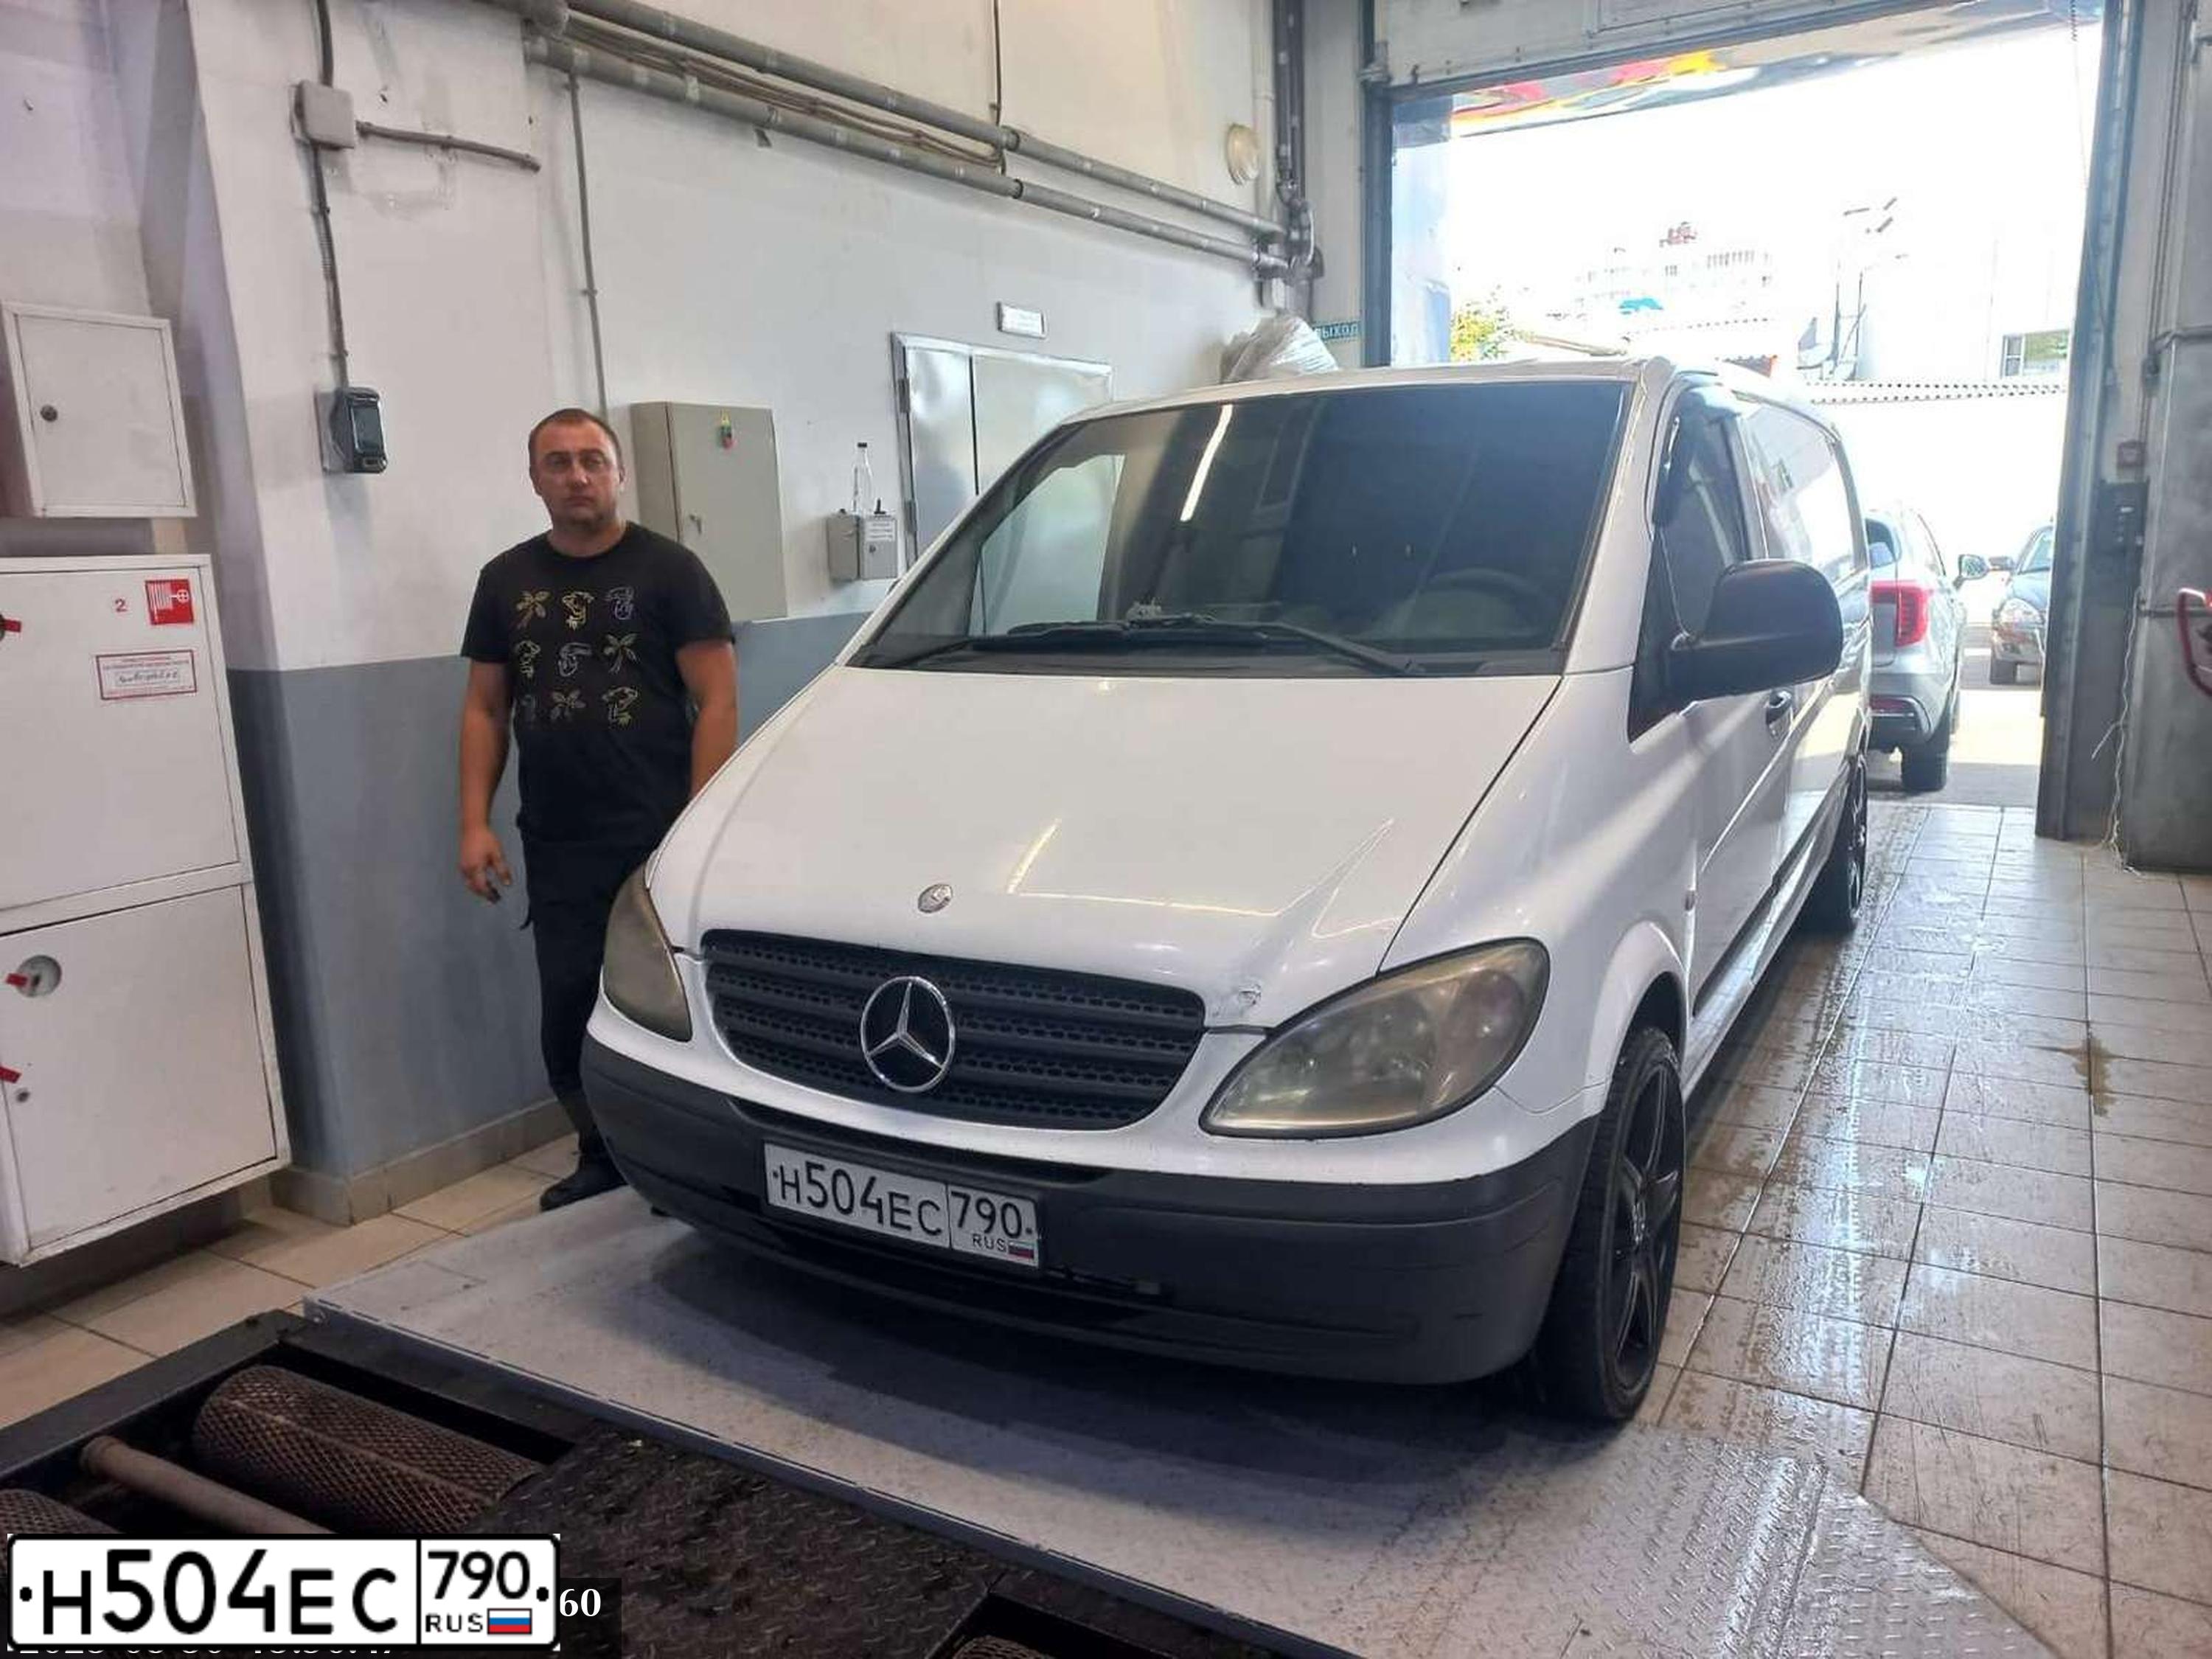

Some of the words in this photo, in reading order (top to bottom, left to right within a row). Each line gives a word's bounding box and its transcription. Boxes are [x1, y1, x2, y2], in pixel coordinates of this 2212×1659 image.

[1315, 323, 1359, 338] ЫХОД
[114, 598, 128, 613] 2
[950, 1190, 1023, 1239] 790
[972, 1233, 1007, 1253] RUS
